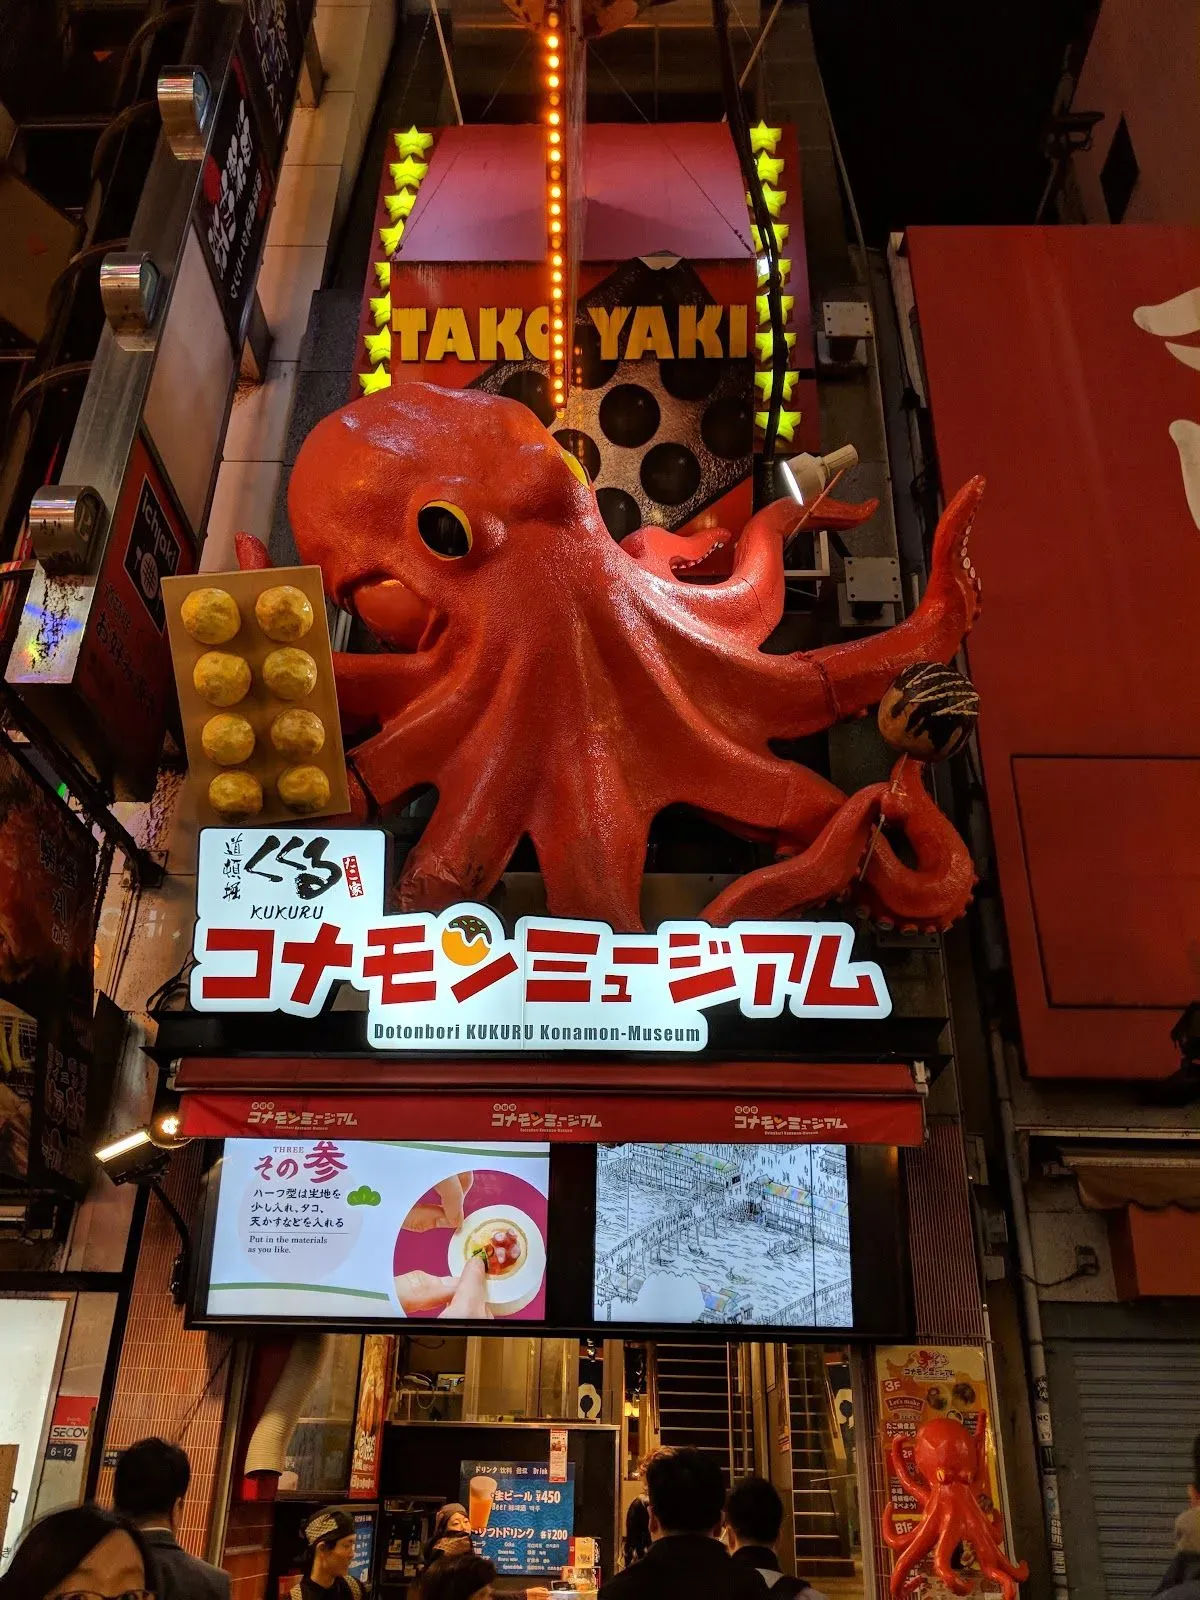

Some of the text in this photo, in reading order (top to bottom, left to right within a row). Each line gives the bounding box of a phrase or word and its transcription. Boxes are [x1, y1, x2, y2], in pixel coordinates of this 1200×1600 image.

[587, 304, 747, 361] YAKI
[221, 832, 244, 903] 道頓堀
[243, 835, 343, 901] くくる
[250, 904, 324, 920] KUKURU
[201, 918, 880, 1008] コナモンミュージアム
[374, 1022, 701, 1042] Dotonbori KUKURU Konamon-Museum
[247, 1110, 358, 1126] コナモンミュージアム
[491, 1111, 603, 1128] コナモンミュージアム
[734, 1114, 849, 1131] コナモンミュージアム
[273, 1146, 304, 1154] THREE
[254, 1140, 348, 1184] その参
[253, 1188, 342, 1200] ハーフ型は生地を
[249, 1216, 345, 1228] 天かすなどを入れる
[249, 1235, 328, 1244] Put in the materials
[247, 1246, 291, 1255] as you like.
[884, 1380, 901, 1392] 3F
[50, 1447, 73, 1457] 6-12
[902, 1450, 912, 1459] 2F
[475, 1466, 498, 1474] ドリンク
[536, 1489, 561, 1504] ¥450
[895, 1523, 913, 1535] B1F
